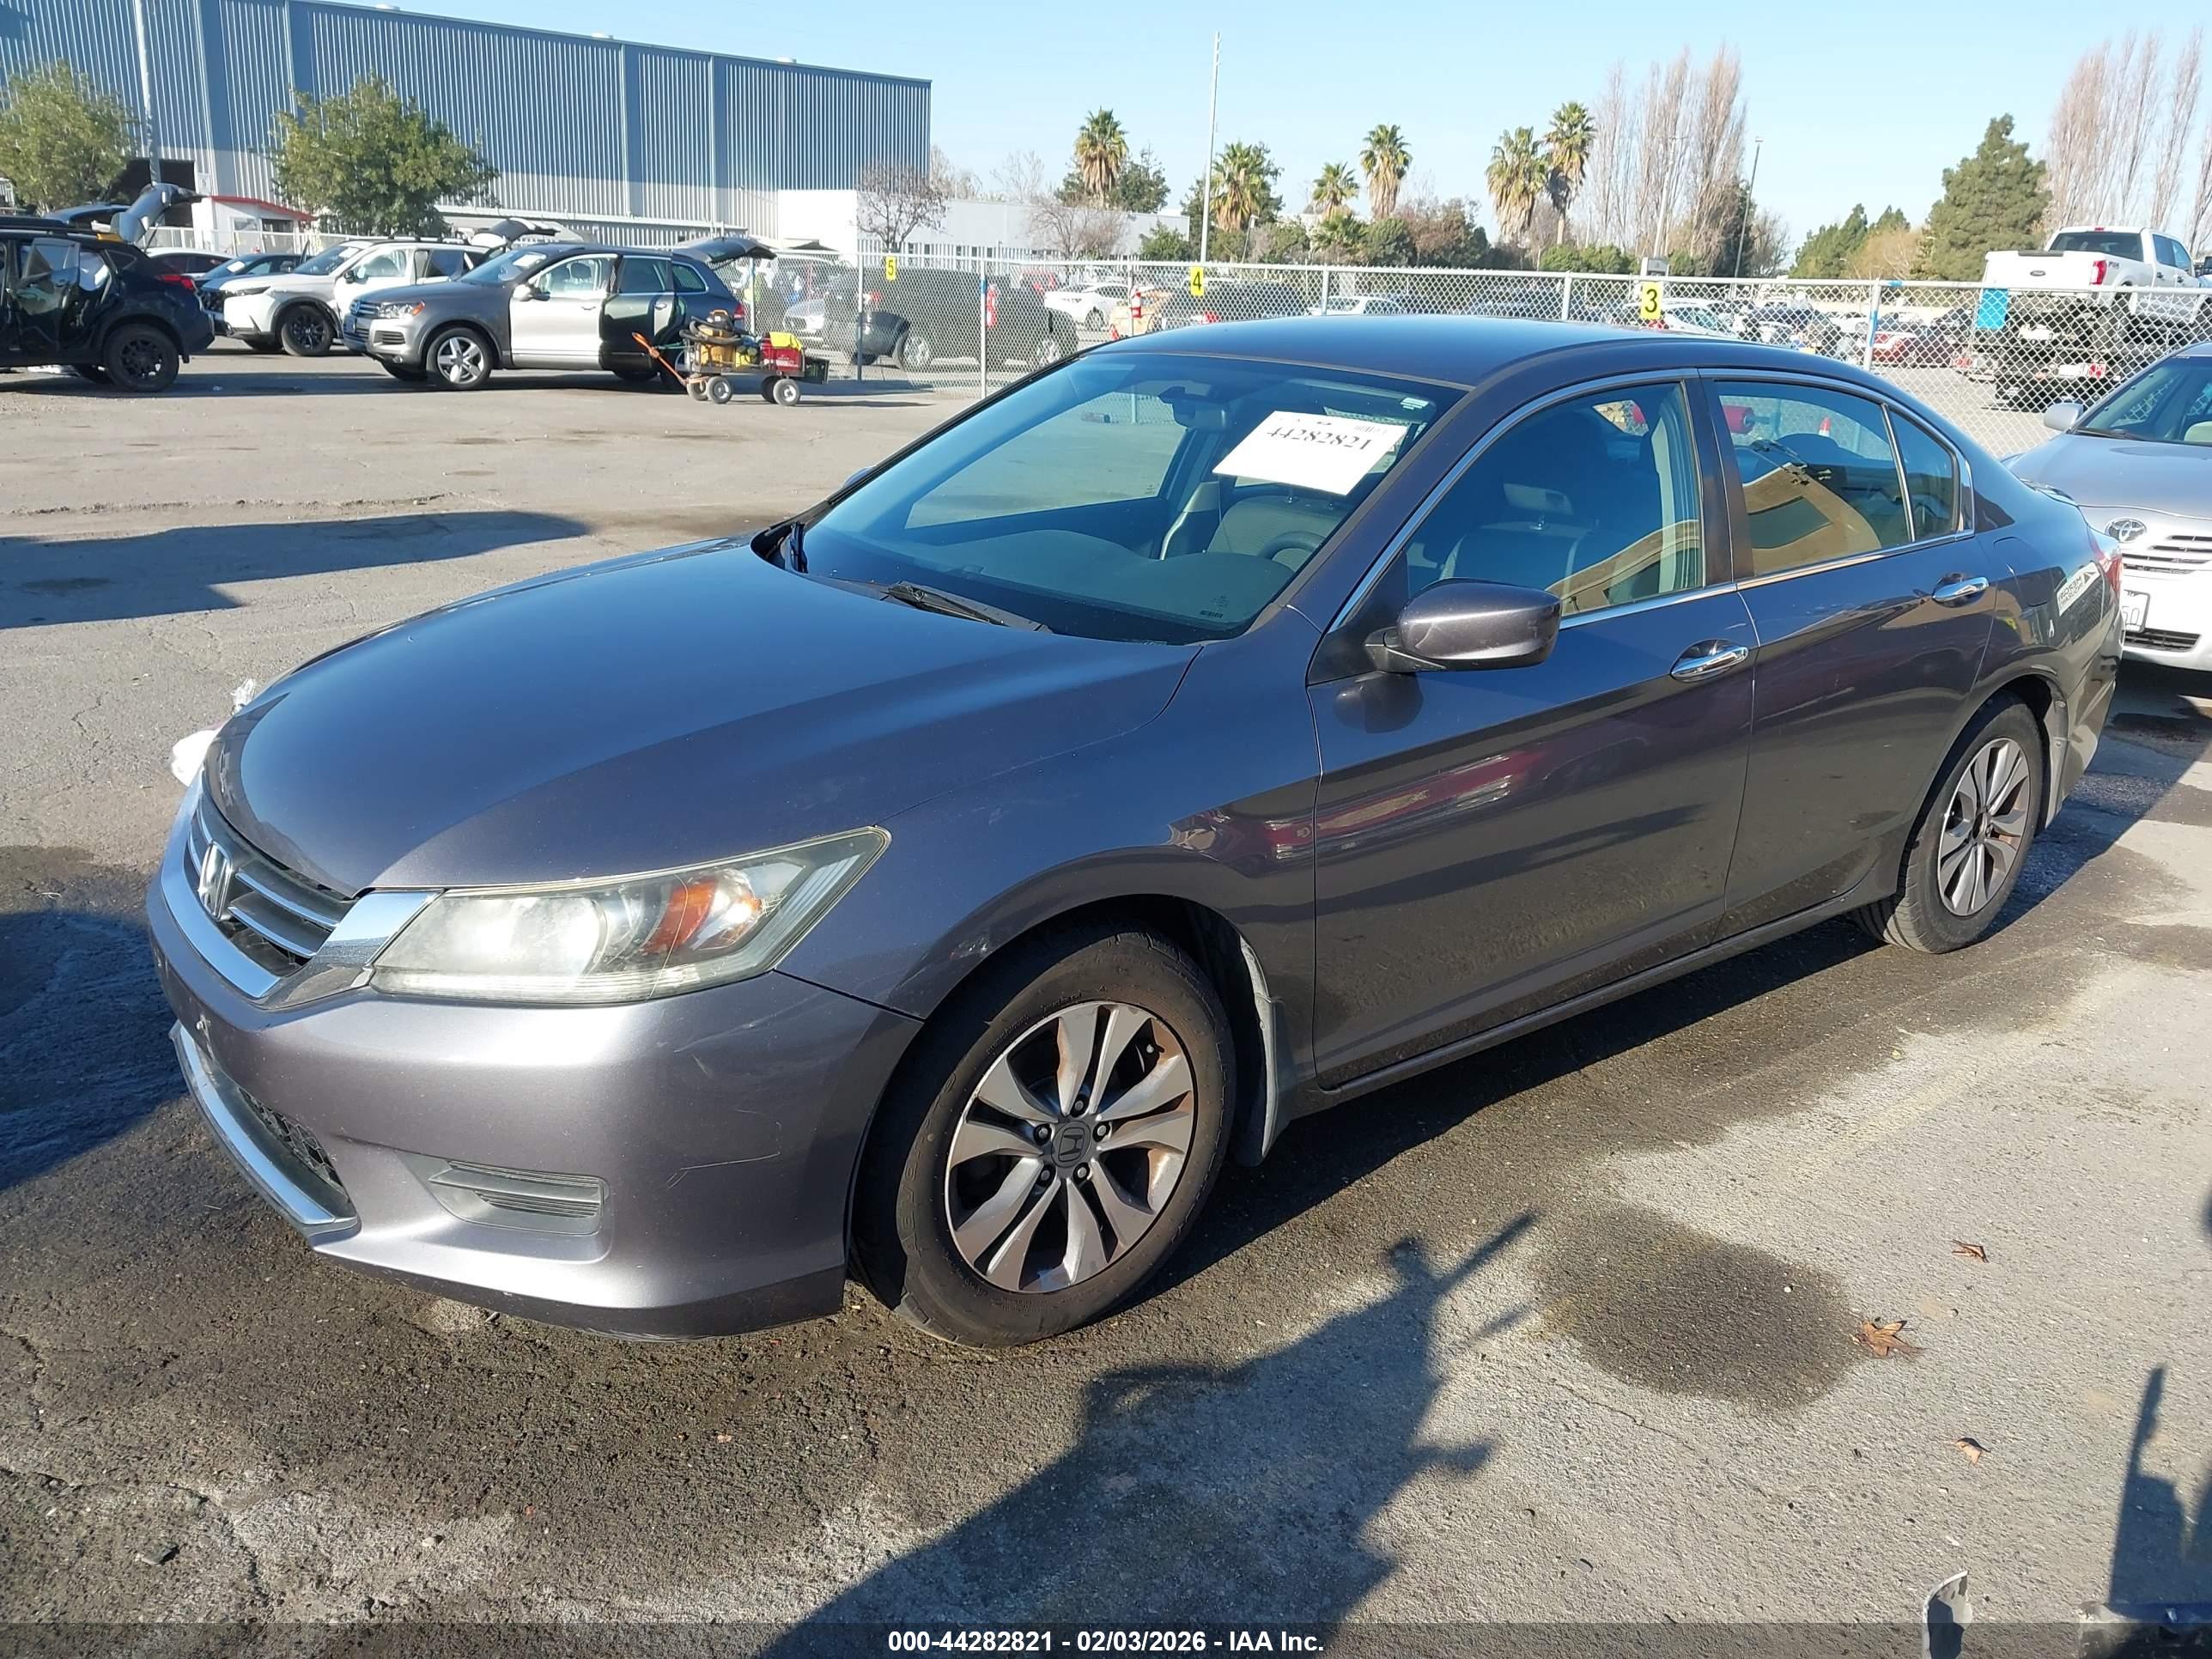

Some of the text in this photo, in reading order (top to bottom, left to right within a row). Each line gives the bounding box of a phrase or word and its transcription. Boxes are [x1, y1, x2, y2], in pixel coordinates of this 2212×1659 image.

[887, 259, 894, 276] 5
[1193, 270, 1202, 291] 4
[1644, 289, 1657, 313] 3
[1267, 427, 1372, 450] 44282821
